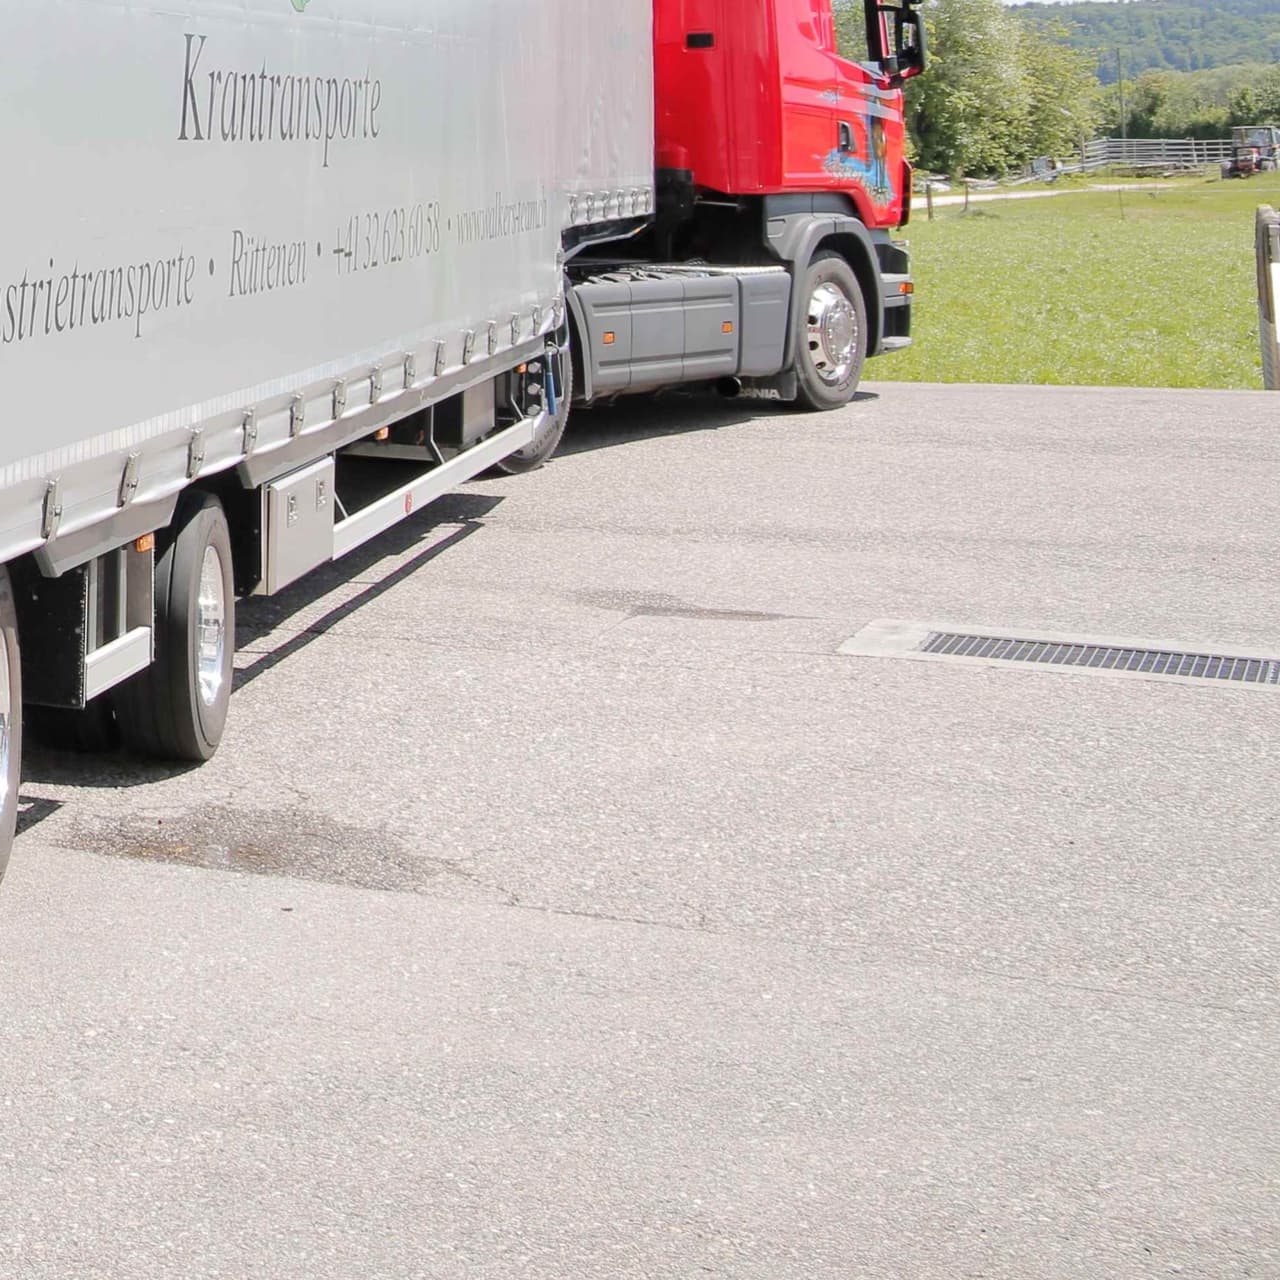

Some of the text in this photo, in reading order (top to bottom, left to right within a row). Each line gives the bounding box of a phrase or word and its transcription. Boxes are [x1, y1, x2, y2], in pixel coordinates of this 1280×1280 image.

[176, 32, 383, 168] Krantransporte
[228, 229, 307, 297] Rüttenen
[332, 215, 360, 275] +41
[363, 212, 380, 270] 32
[382, 207, 406, 265] 623
[408, 203, 424, 259] 60
[426, 201, 441, 254] 58
